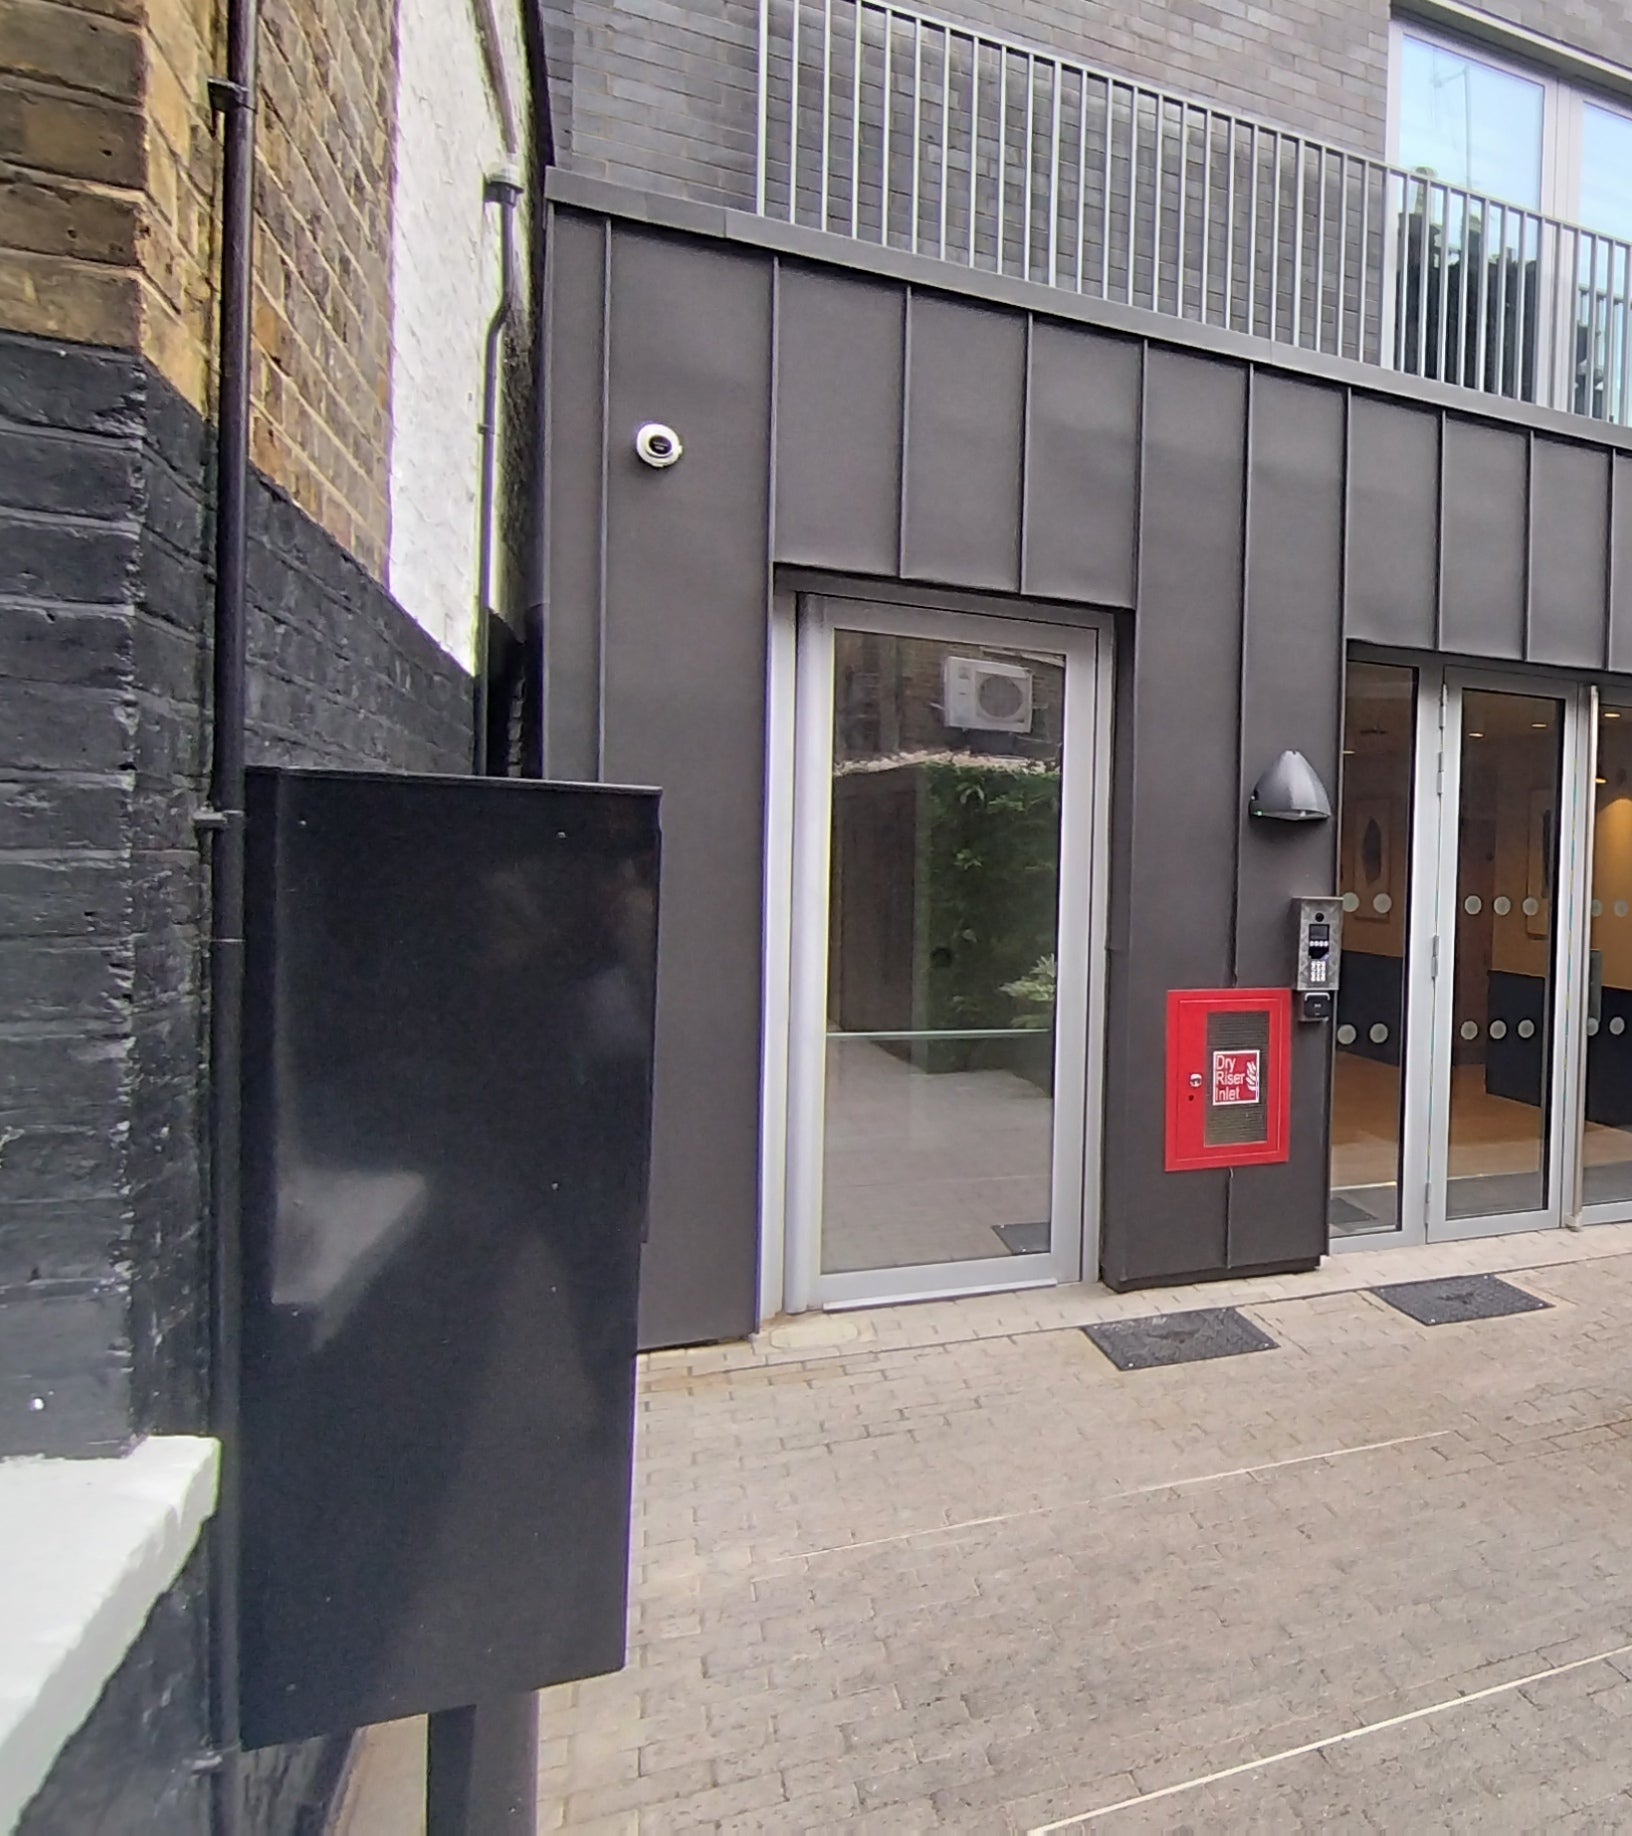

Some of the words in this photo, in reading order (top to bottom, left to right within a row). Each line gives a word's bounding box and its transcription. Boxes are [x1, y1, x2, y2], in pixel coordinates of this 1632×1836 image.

[1217, 1055, 1237, 1073] Dry
[1217, 1070, 1246, 1085] Riser
[1215, 1086, 1240, 1101] Inlet
